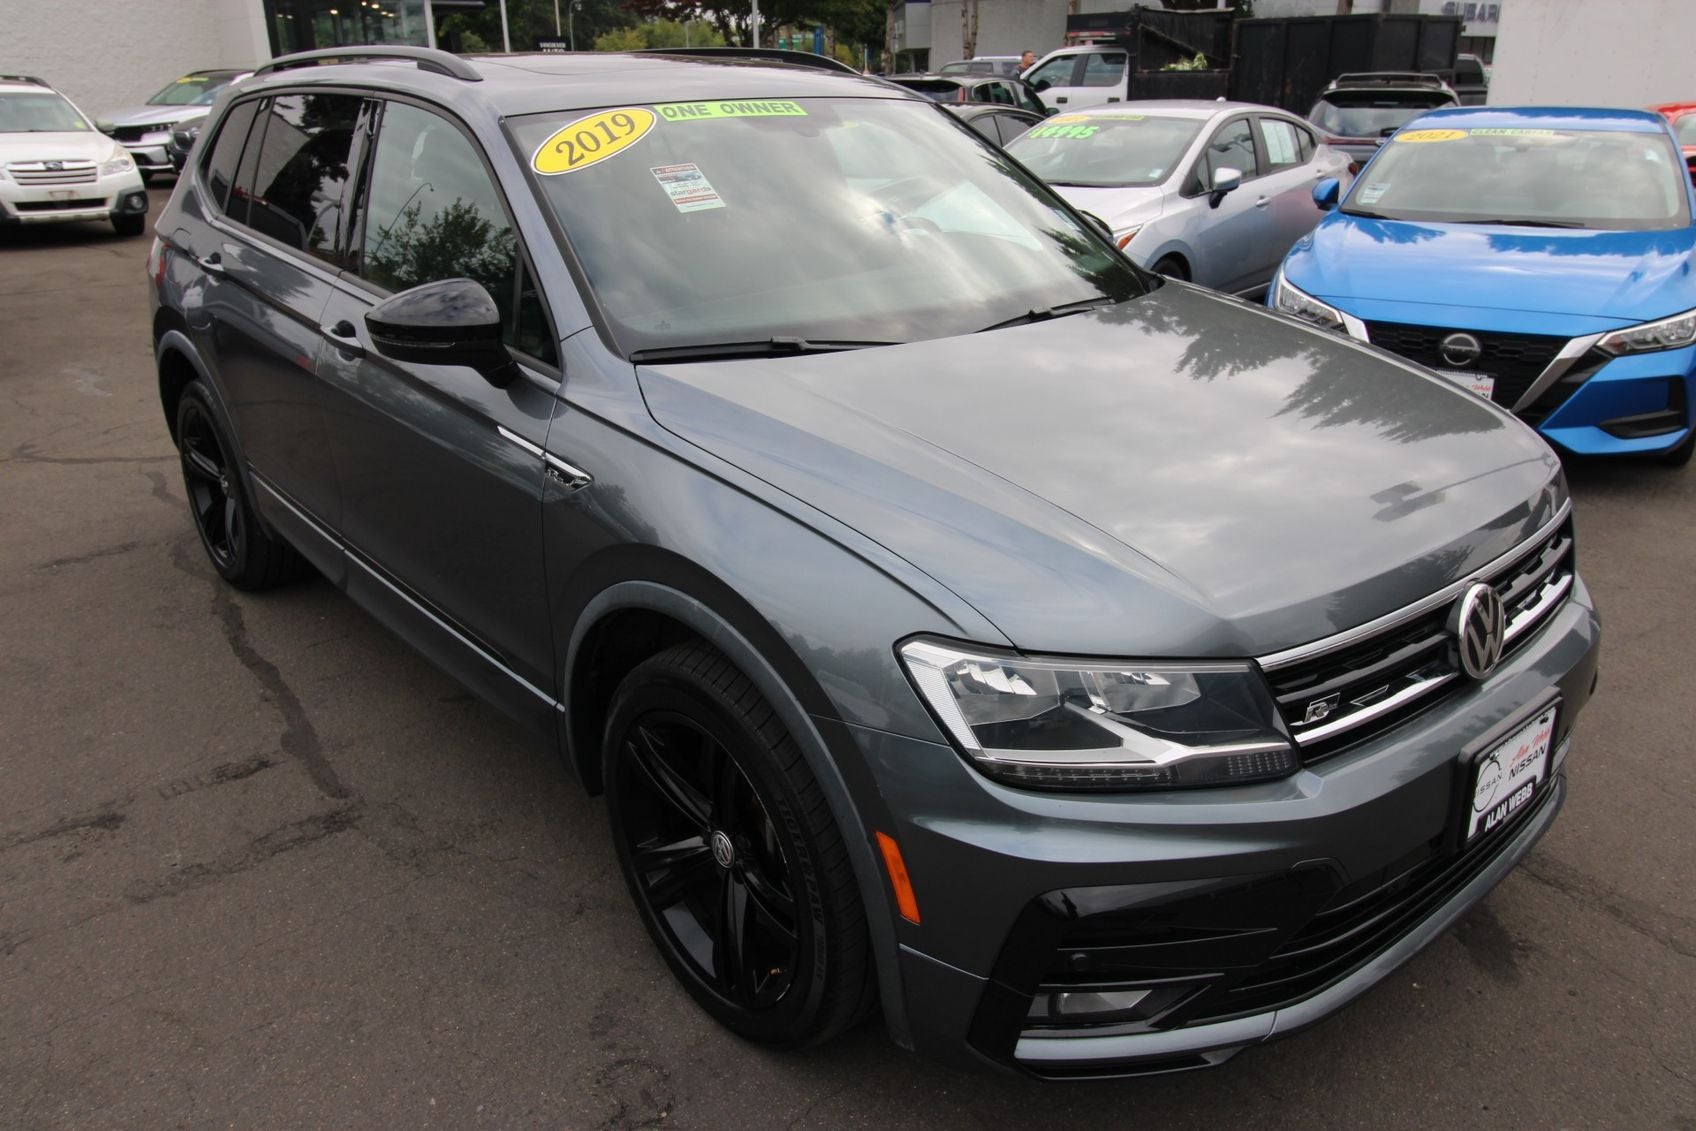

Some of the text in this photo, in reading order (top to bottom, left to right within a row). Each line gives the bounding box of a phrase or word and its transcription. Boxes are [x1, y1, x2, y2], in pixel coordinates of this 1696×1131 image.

[663, 102, 800, 118] ONE OWNER
[555, 113, 636, 166] 2019
[1508, 743, 1546, 780] NISSAN
[1475, 773, 1502, 796] ISSAN
[1484, 781, 1534, 833] ALAN WEBB
